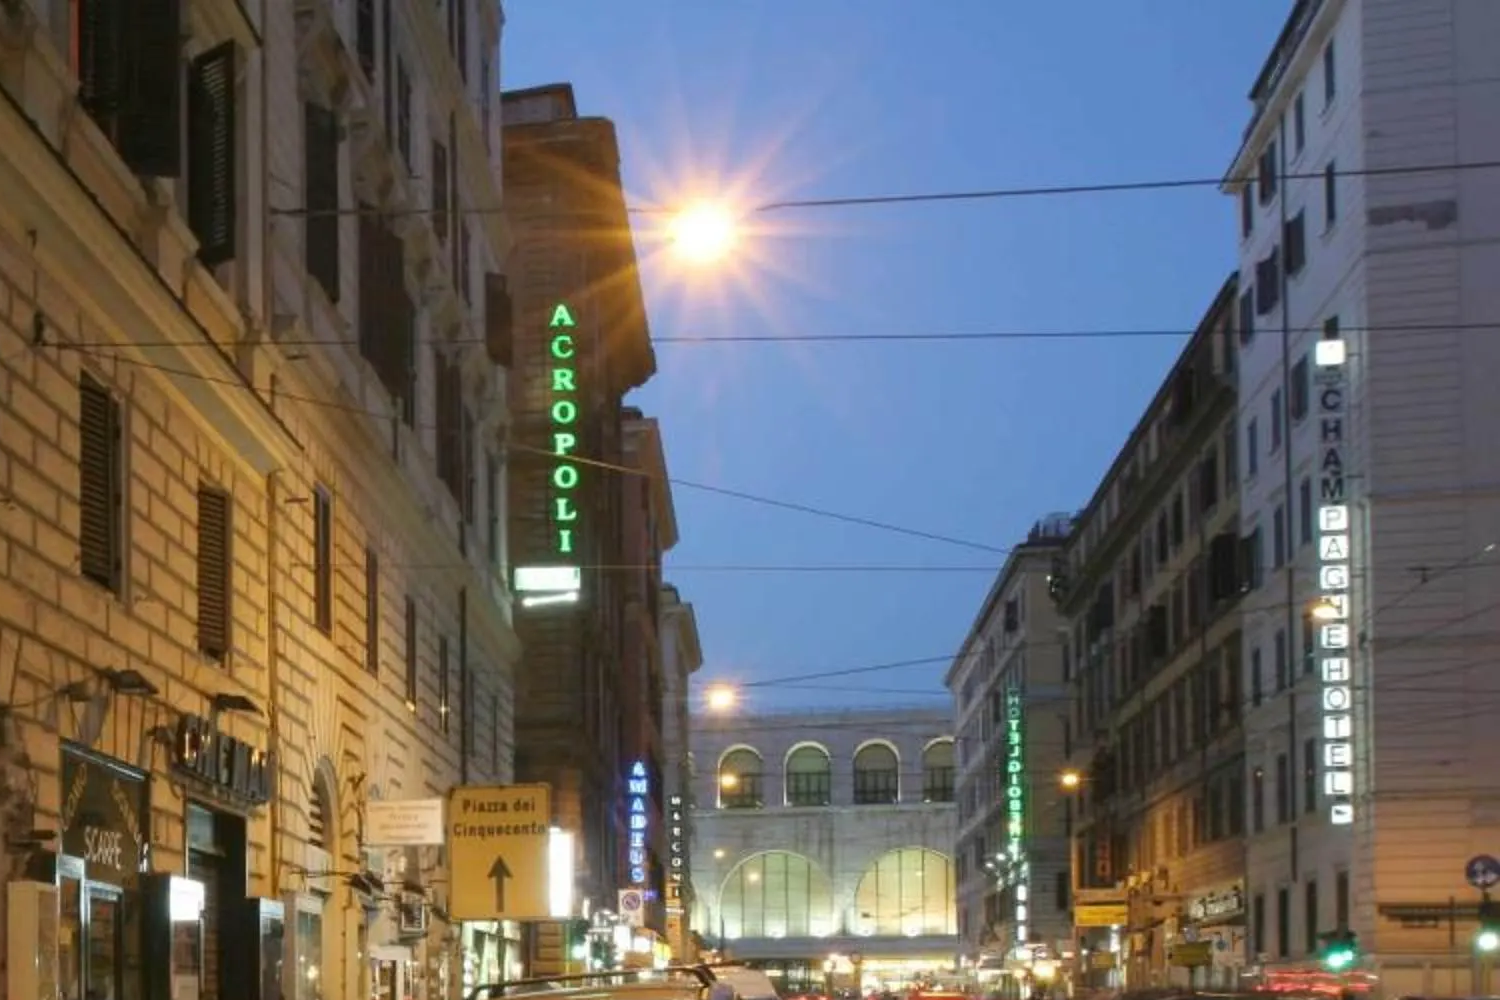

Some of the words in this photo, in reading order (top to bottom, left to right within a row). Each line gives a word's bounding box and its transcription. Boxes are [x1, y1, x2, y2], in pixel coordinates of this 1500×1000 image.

[551, 304, 578, 553] ACROPOLI
[1326, 659, 1350, 794] HOTEL
[453, 821, 547, 841] Cinquecento
[462, 798, 508, 814] Piazza
[513, 798, 536, 813] dei
